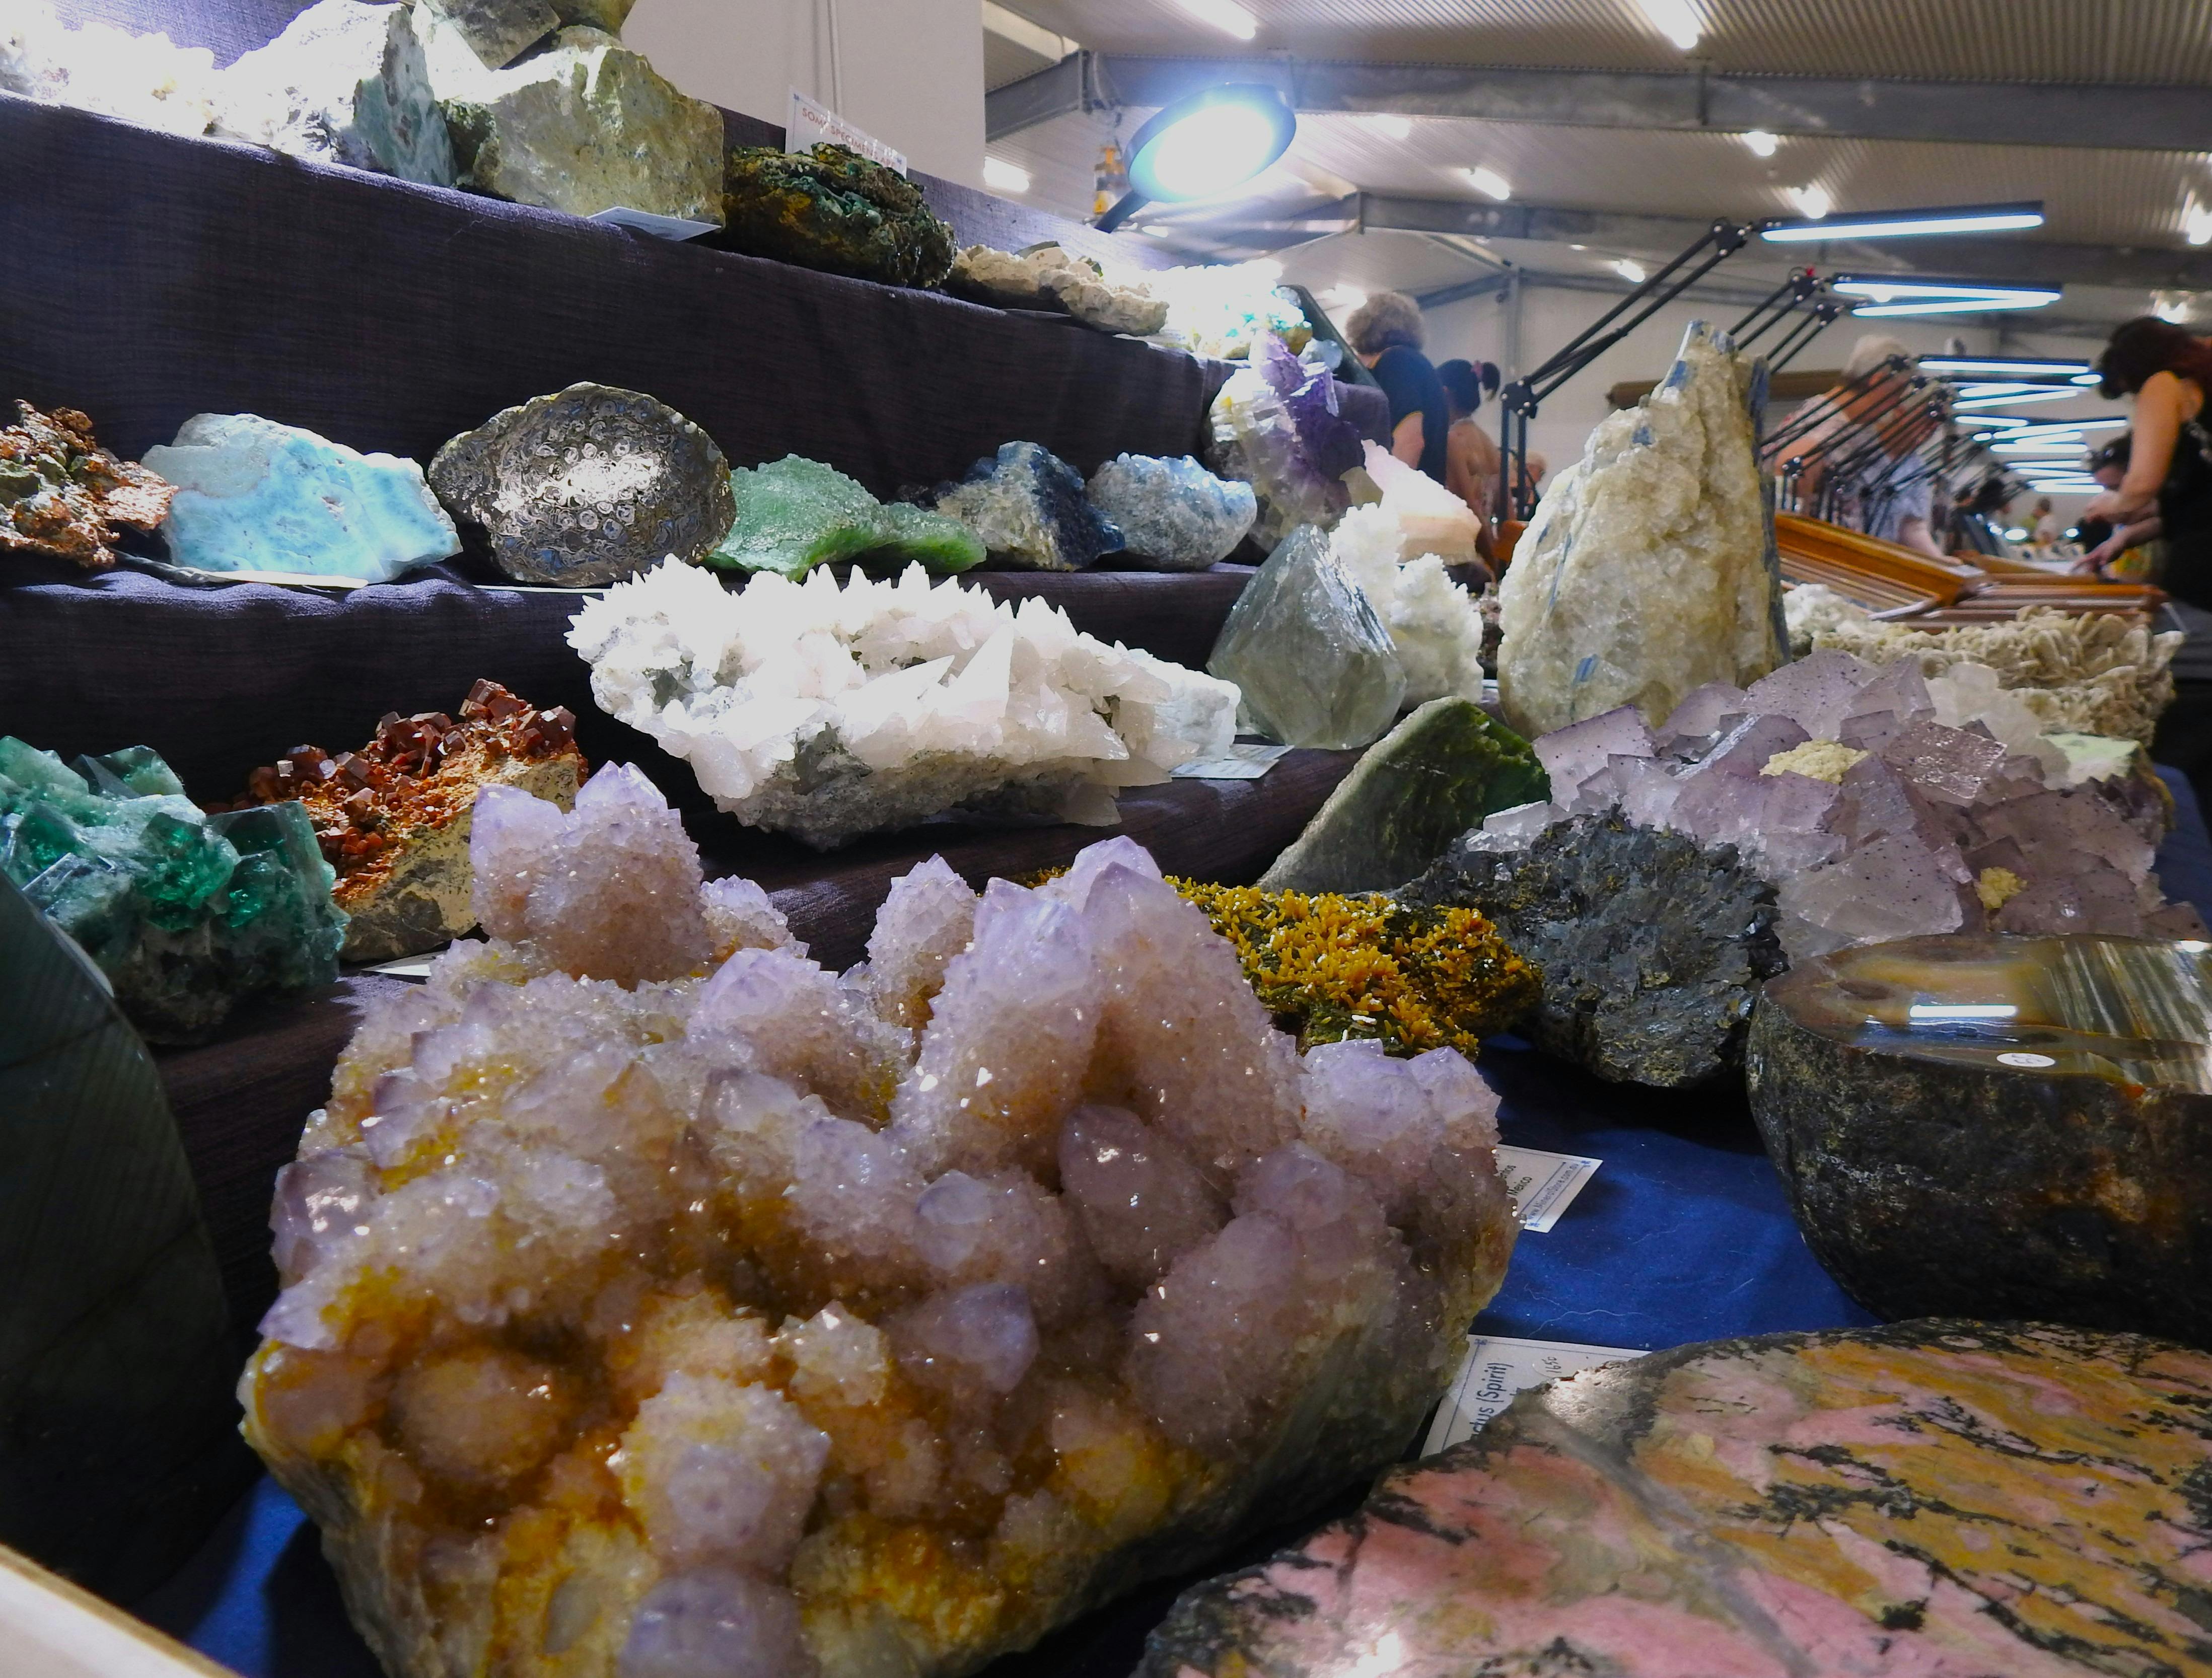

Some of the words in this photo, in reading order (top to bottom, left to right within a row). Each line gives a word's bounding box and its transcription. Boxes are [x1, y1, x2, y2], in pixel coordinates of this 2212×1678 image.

[1506, 1176, 1533, 1196] Mexico
[1541, 1356, 1562, 1373] 1650
[1475, 1362, 1515, 1403] (Spirit)
[1469, 1407, 1494, 1434] ctus
